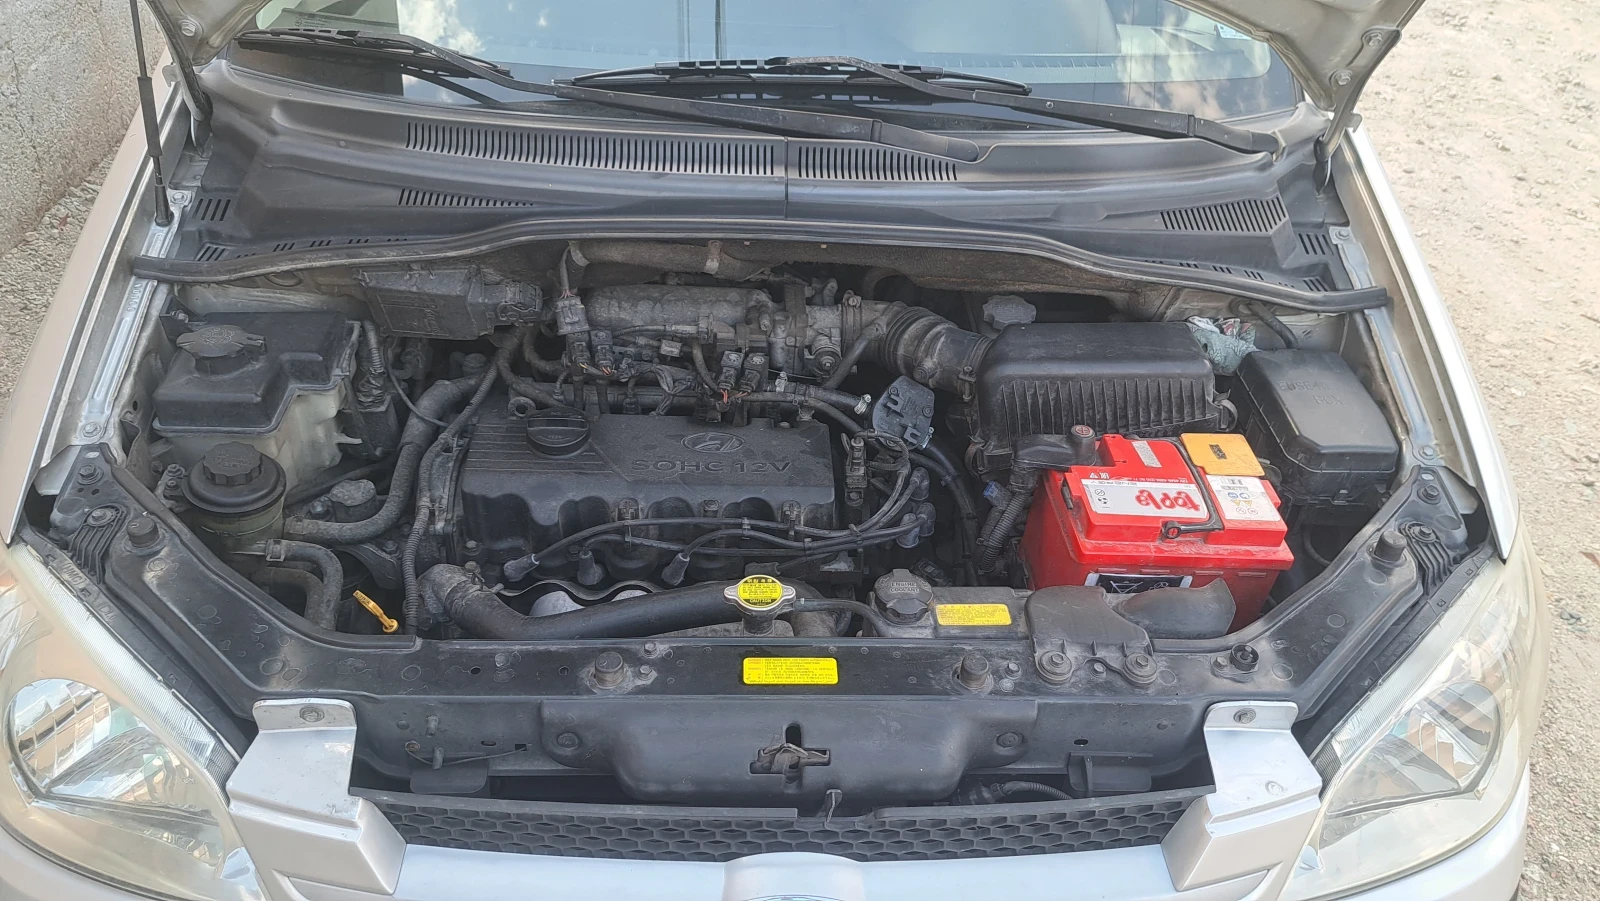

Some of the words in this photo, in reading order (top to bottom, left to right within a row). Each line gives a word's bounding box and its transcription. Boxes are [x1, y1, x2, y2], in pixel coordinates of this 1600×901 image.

[631, 459, 724, 472] SOHC
[735, 461, 792, 473] 12V
[1135, 489, 1200, 511] topla
